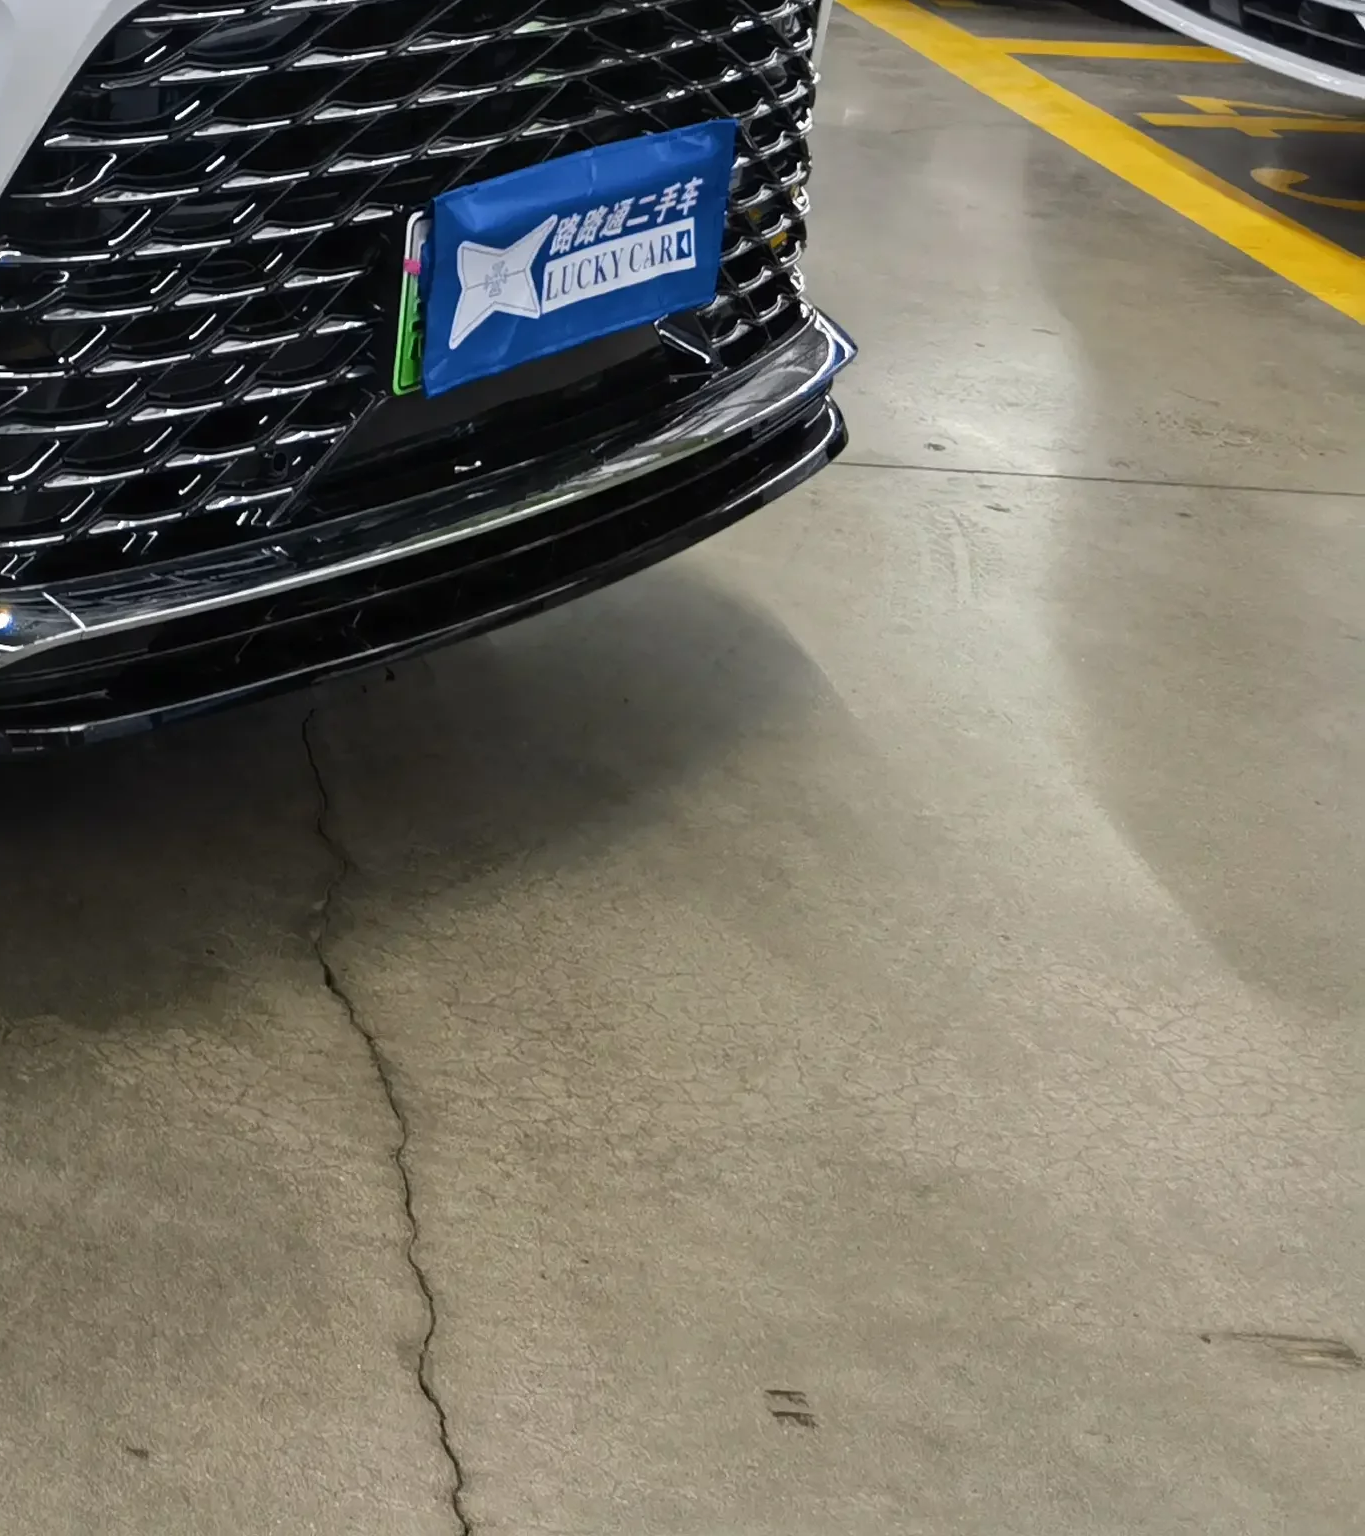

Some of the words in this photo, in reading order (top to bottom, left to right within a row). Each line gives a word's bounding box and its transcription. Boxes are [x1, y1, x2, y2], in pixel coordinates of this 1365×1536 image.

[549, 176, 704, 256] 路路通二手车
[545, 247, 624, 302] LUCKY
[628, 233, 674, 273] CAR
